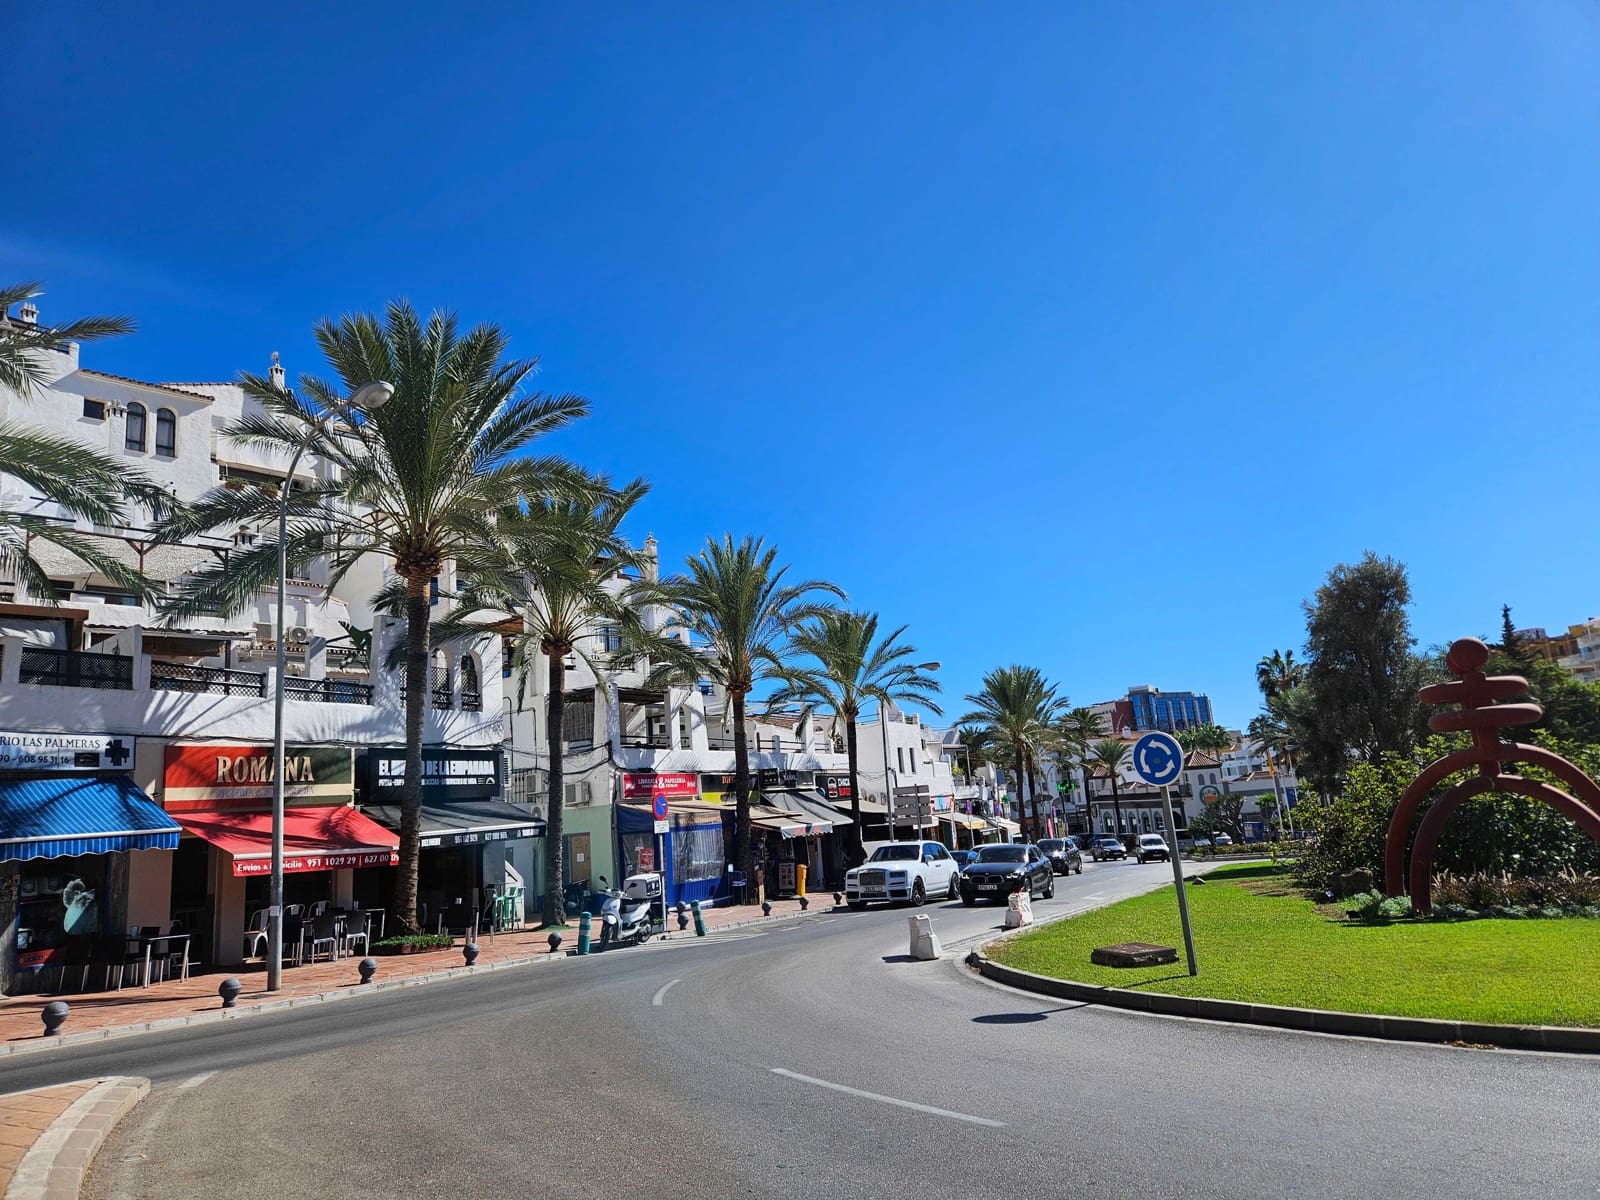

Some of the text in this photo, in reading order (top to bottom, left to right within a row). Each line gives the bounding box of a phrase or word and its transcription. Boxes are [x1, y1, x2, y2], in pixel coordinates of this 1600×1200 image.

[22, 737, 43, 747] LAS
[45, 738, 101, 749] PALMERAS
[18, 754, 36, 764] 608
[38, 755, 49, 764] 95
[60, 756, 70, 764] 16
[378, 759, 391, 776] EL
[306, 857, 322, 867] 951
[324, 856, 345, 866] 1029
[346, 856, 357, 865] 29
[364, 854, 379, 864] 627
[379, 854, 390, 863] 00
